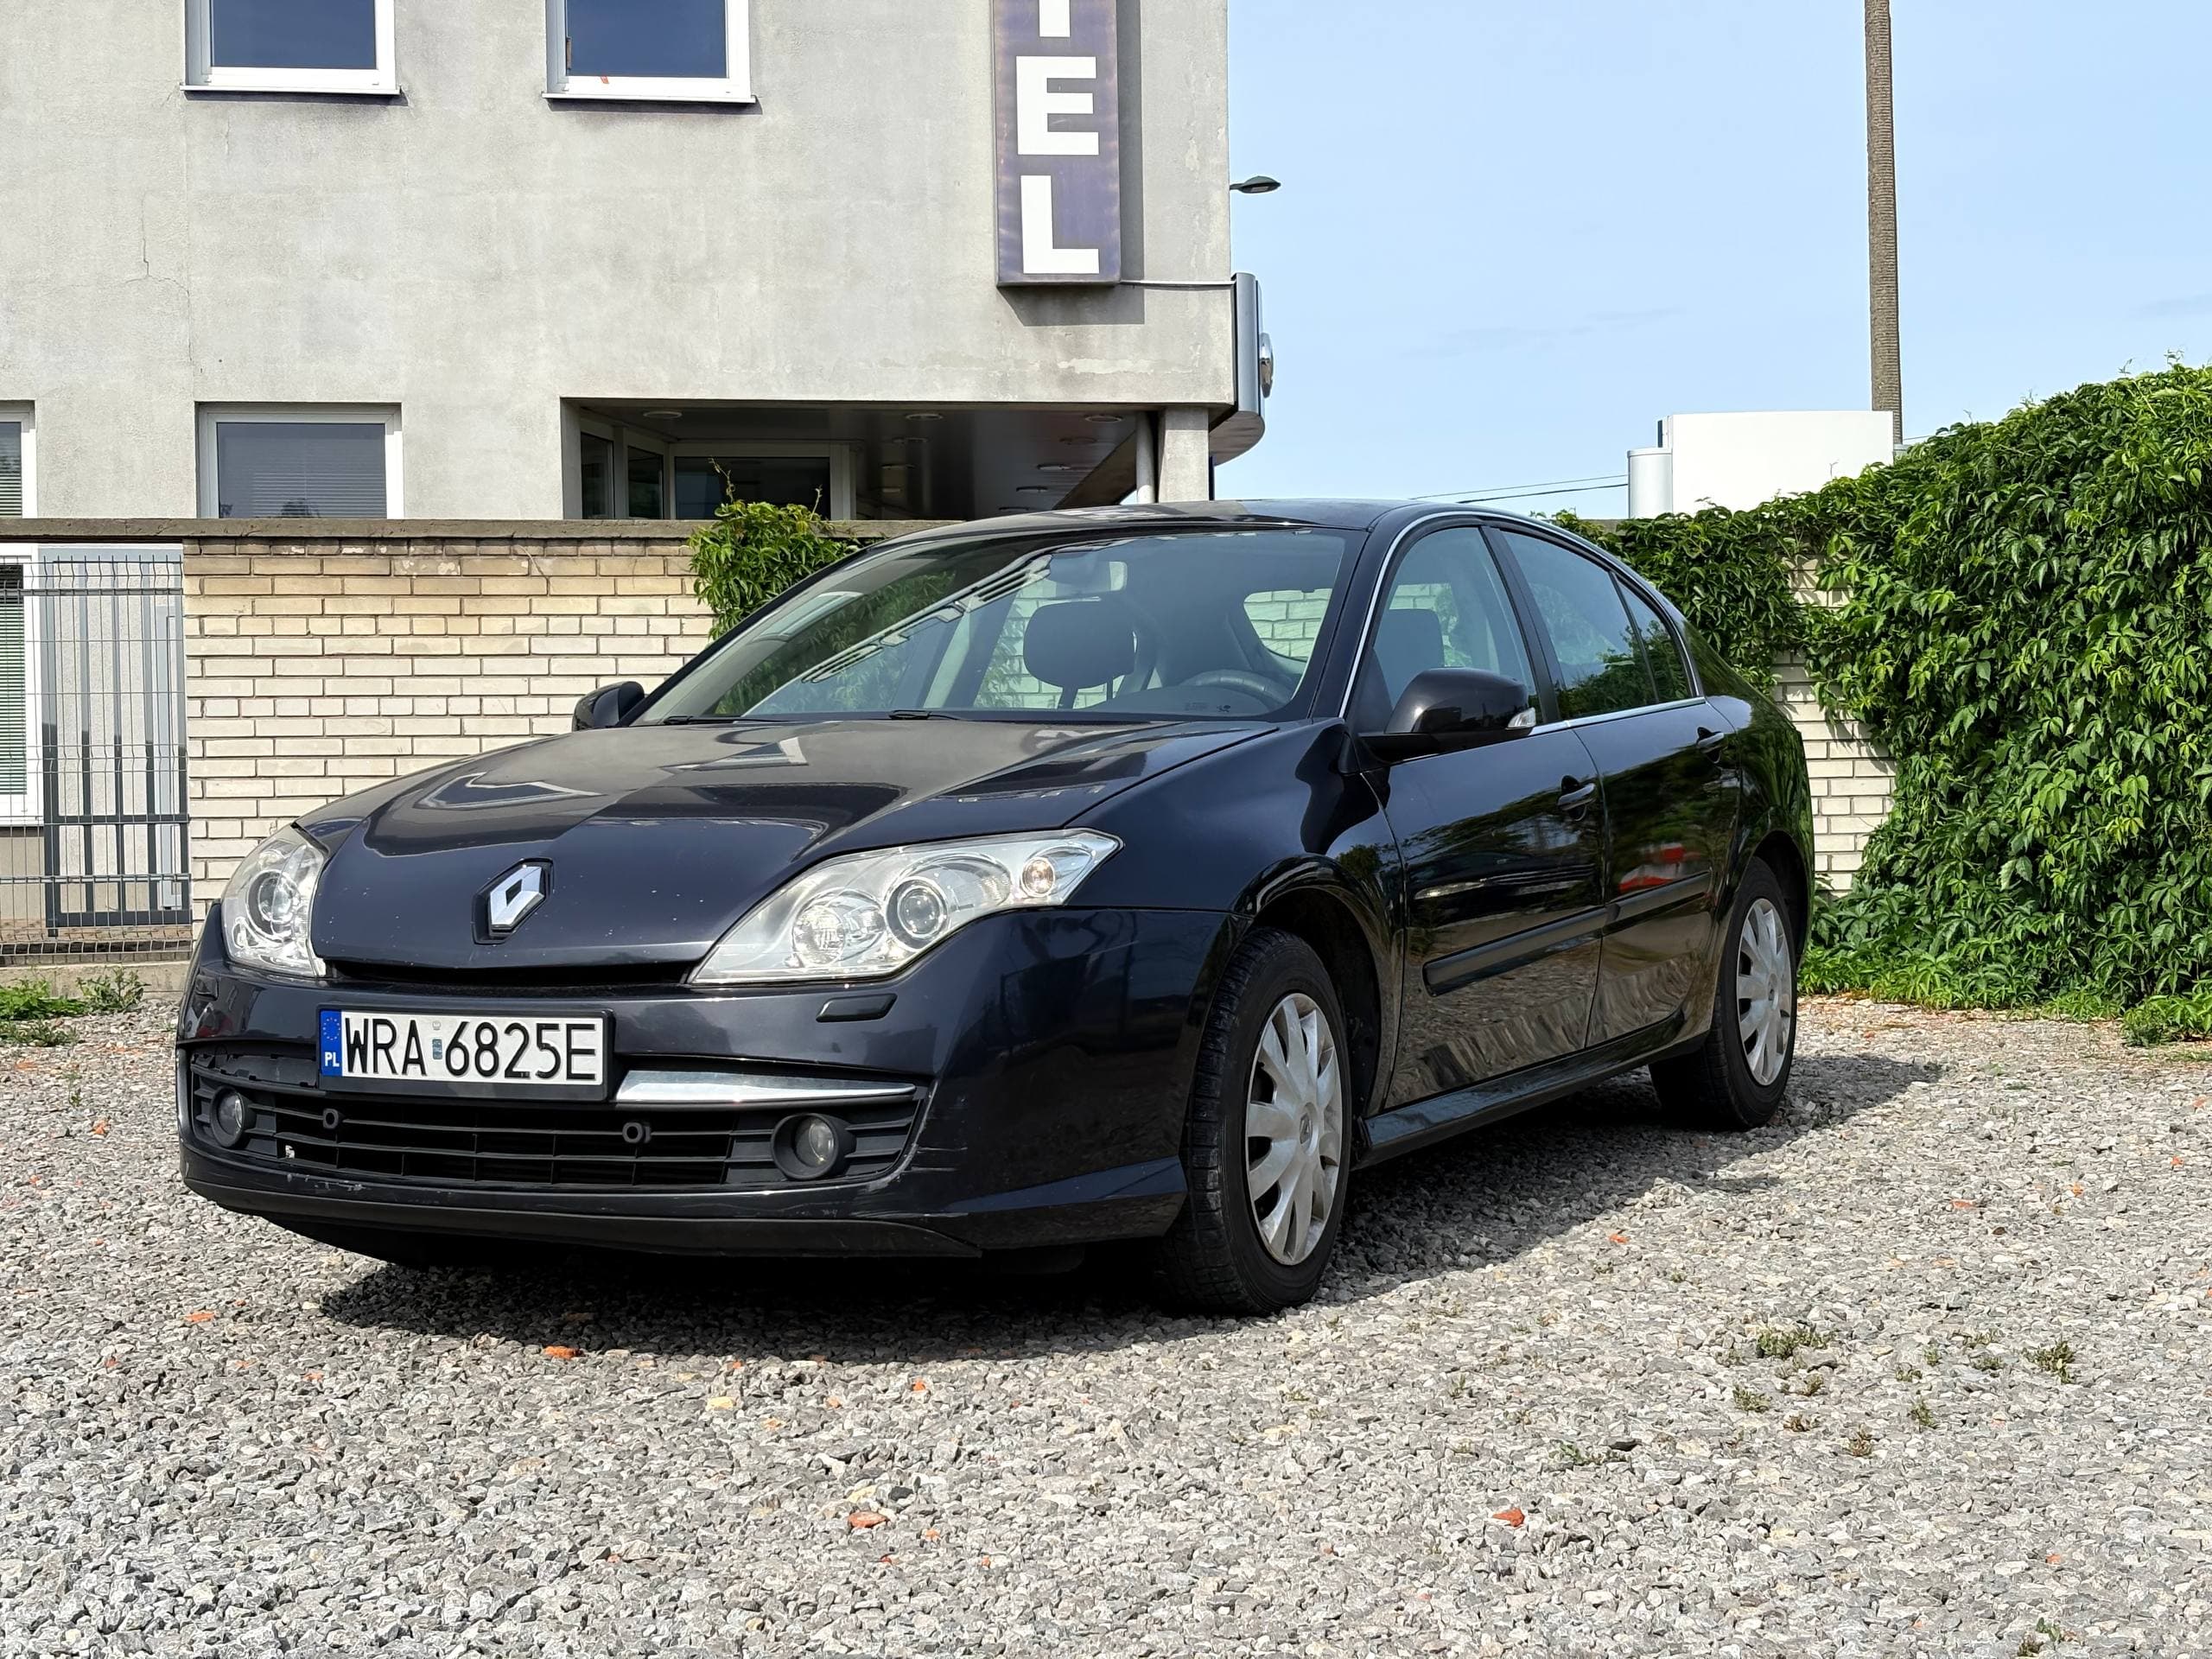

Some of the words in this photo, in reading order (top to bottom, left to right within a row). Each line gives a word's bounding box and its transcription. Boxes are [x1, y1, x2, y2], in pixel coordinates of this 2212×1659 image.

[324, 1052, 340, 1067] PL
[345, 1017, 428, 1076] WRA
[445, 1020, 595, 1080] 6825E
